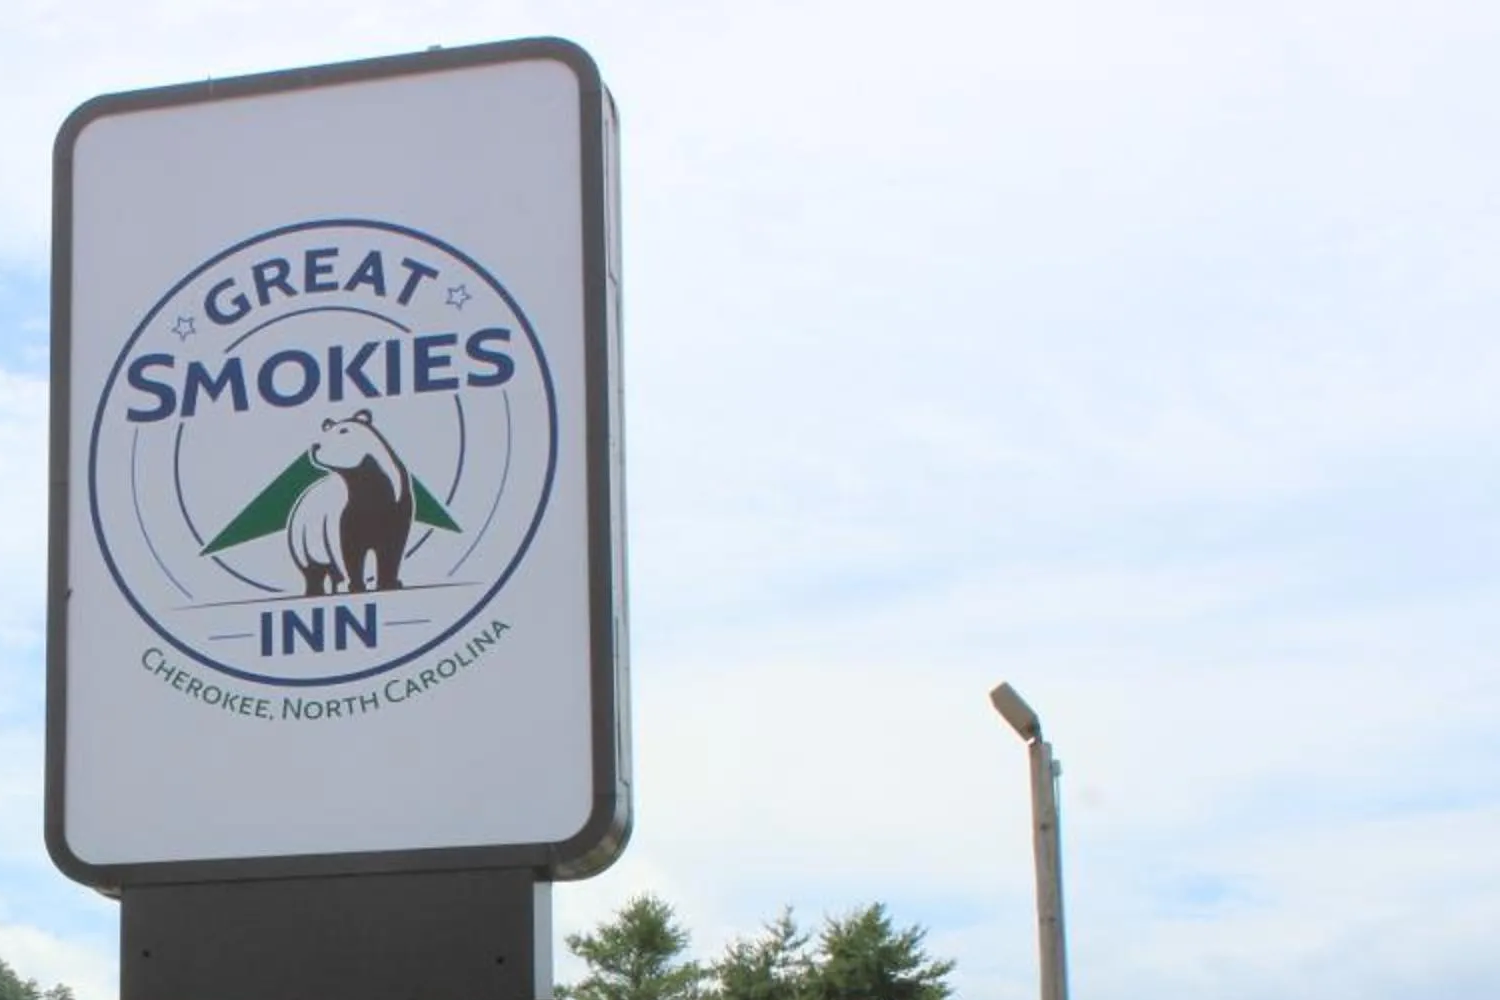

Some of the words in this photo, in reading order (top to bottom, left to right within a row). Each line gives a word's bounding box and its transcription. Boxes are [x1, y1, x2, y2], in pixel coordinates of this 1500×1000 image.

[203, 248, 440, 326] GREAT
[126, 328, 516, 424] SMOKIES
[141, 647, 275, 721] CHEROKEE,
[282, 692, 380, 721] NORTH
[384, 619, 512, 704] CAROLINA
[260, 603, 377, 657] INN
